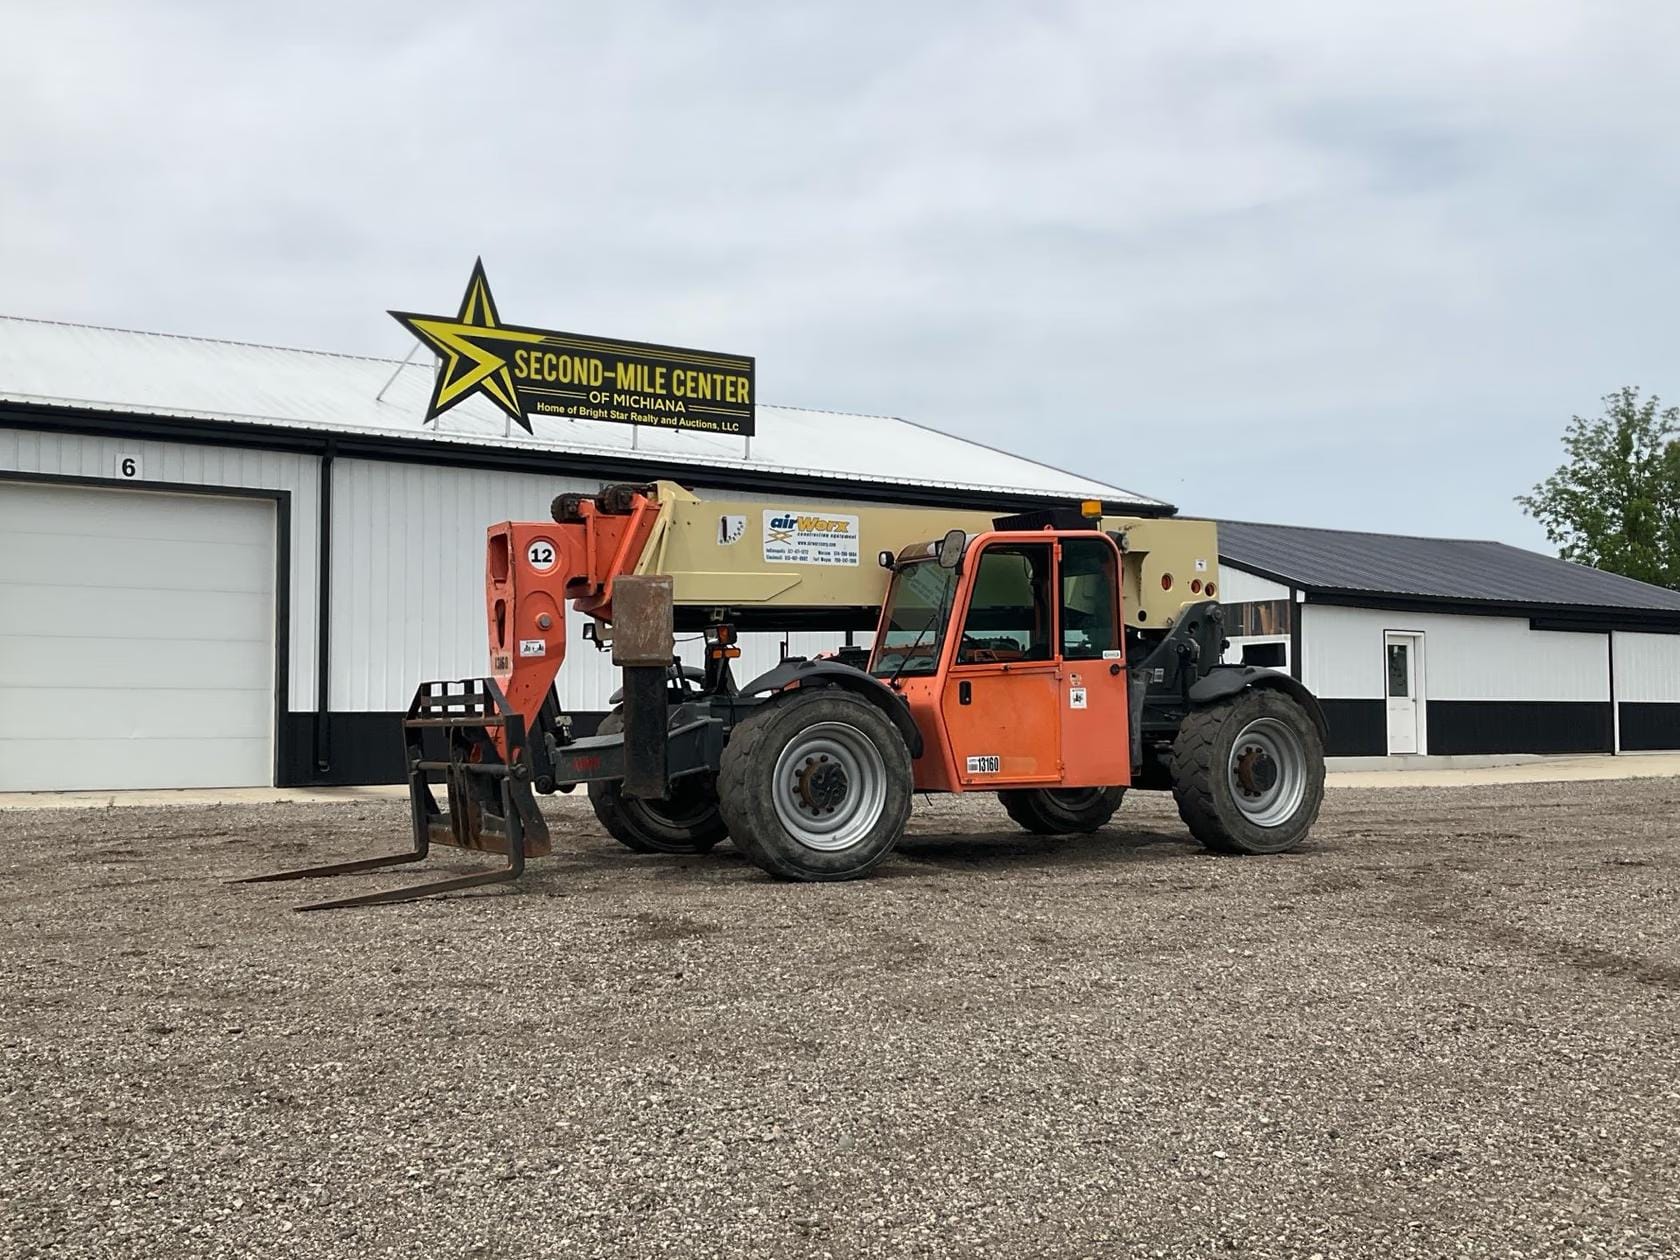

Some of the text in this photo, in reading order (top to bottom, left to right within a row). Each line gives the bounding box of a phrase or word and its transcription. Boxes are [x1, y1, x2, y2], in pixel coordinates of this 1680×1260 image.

[514, 349, 750, 404] SECOND-MILE CENTER
[589, 391, 686, 413] OF MICHIANA
[537, 402, 739, 432] Home of Bright Star Realty and Auctions, LLC
[122, 458, 136, 477] 6
[531, 549, 552, 563] 12
[978, 757, 998, 772] 13160
